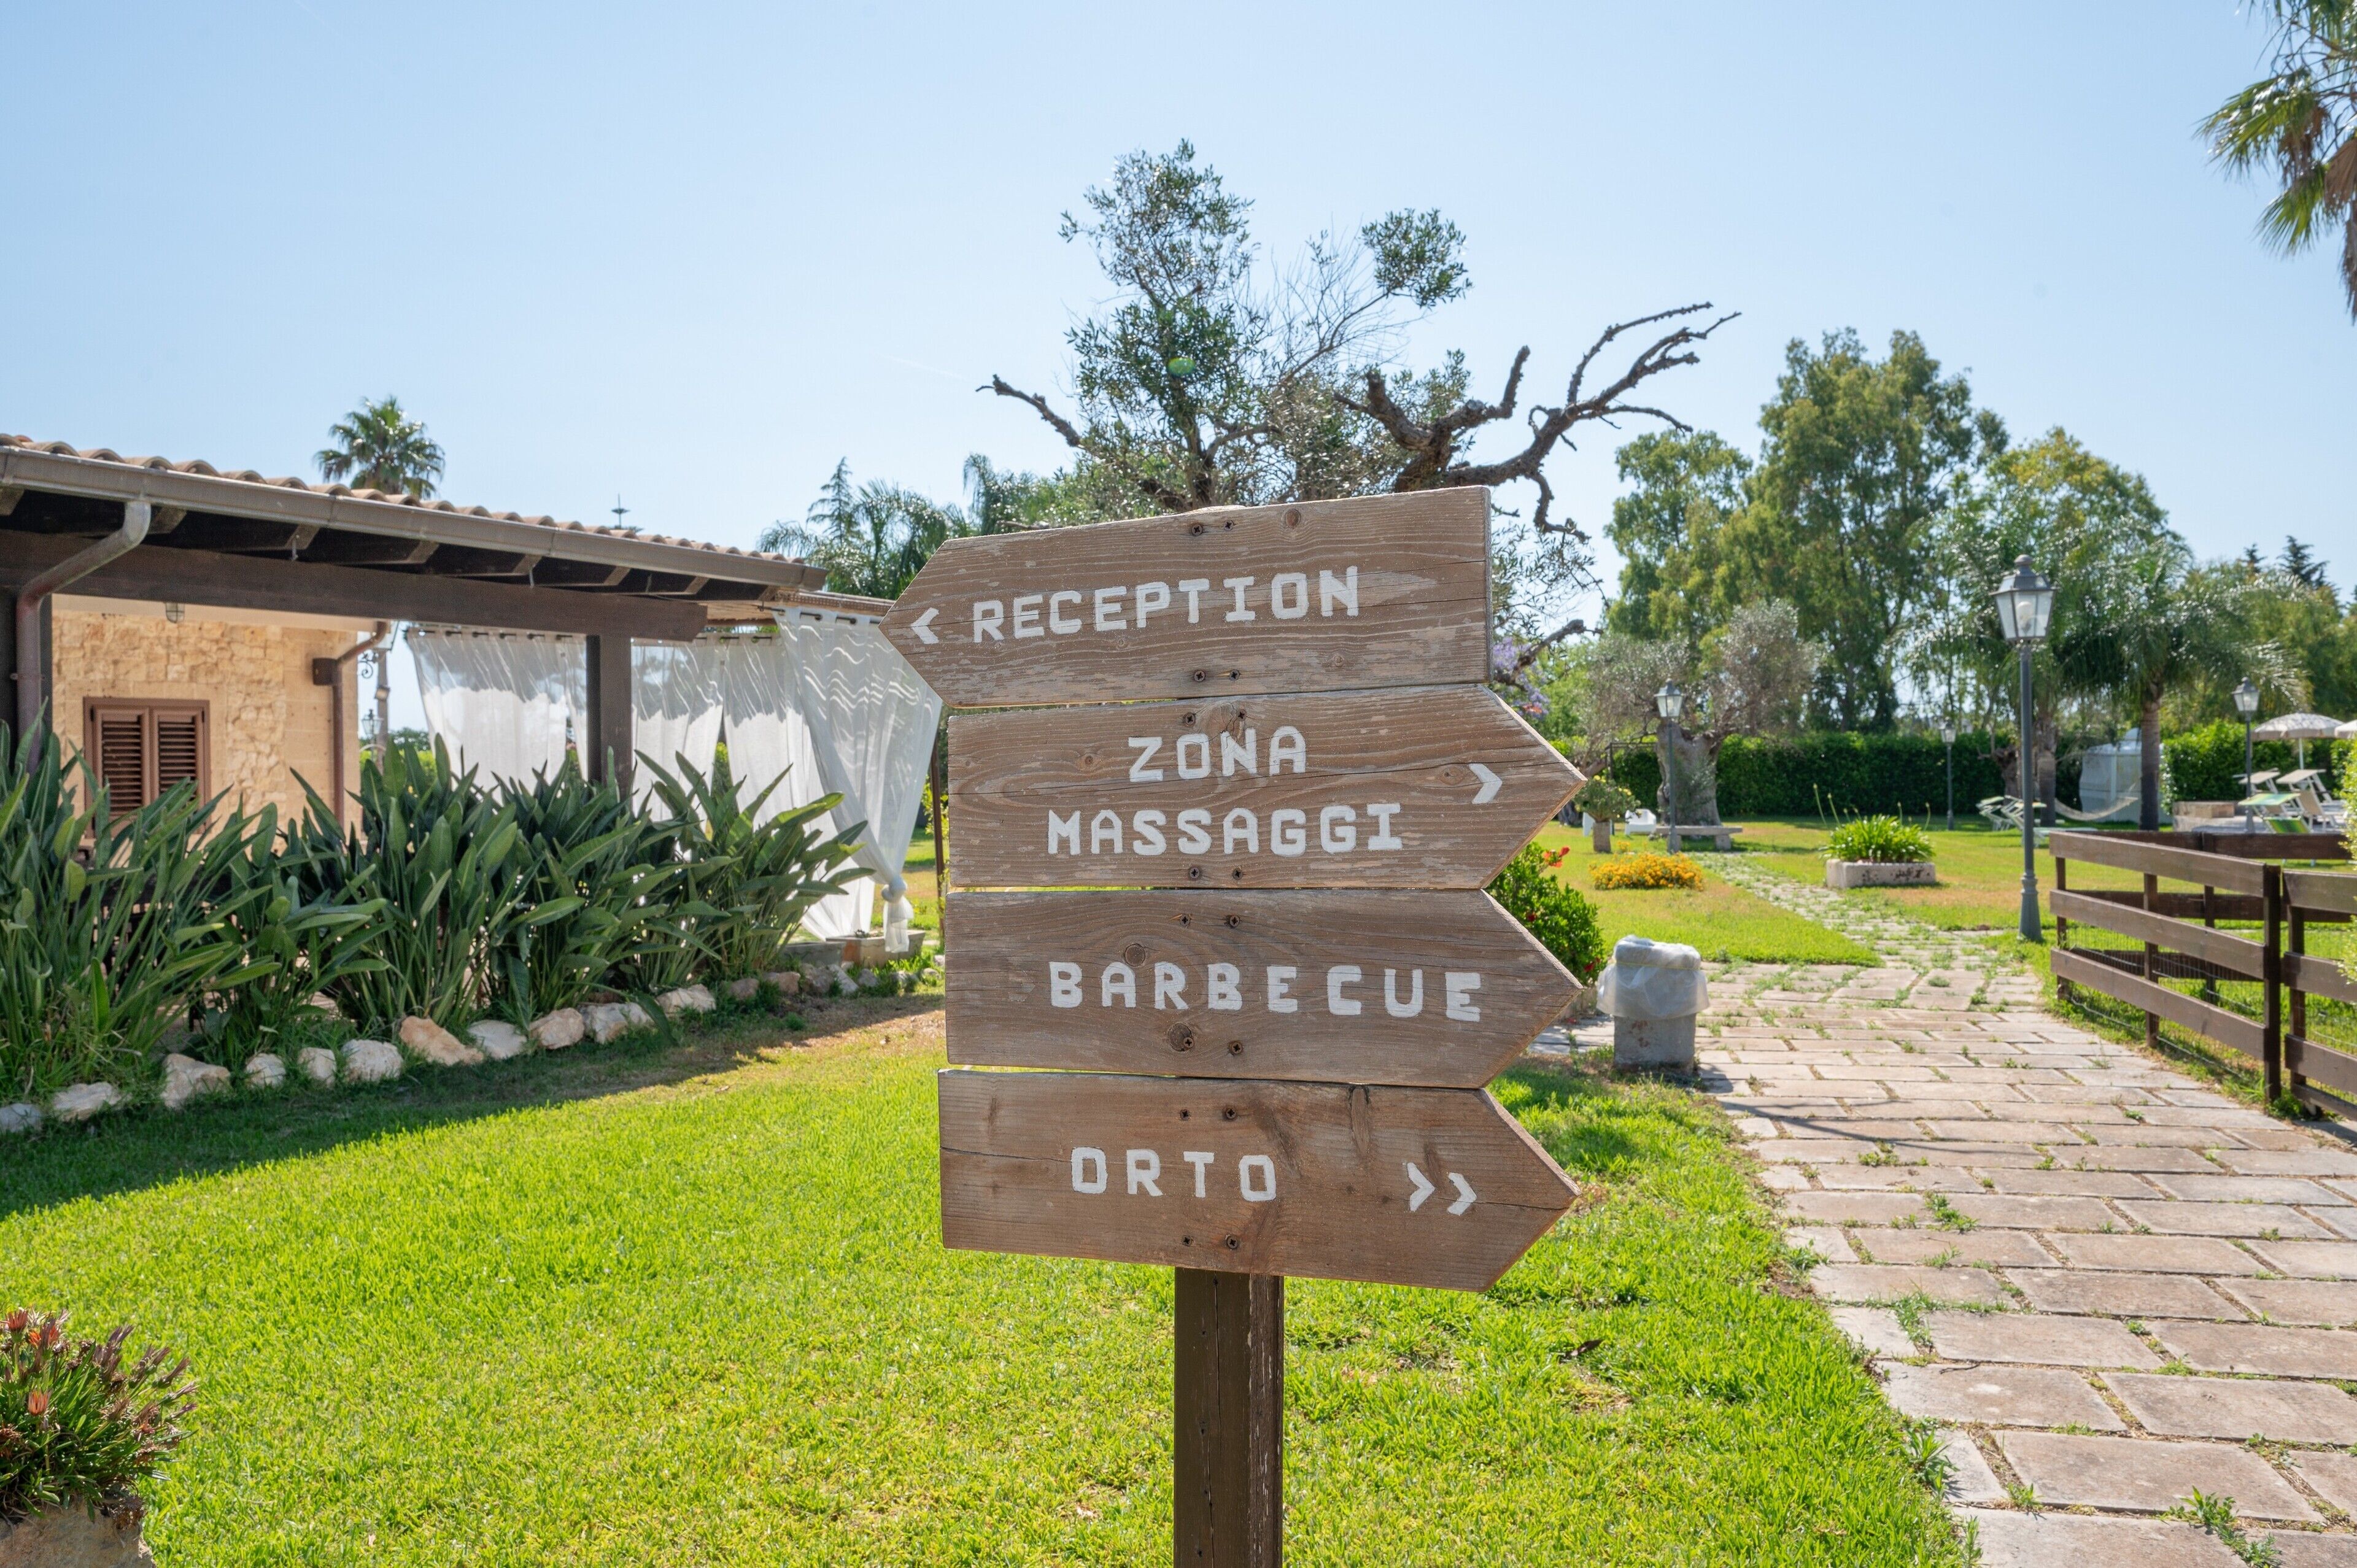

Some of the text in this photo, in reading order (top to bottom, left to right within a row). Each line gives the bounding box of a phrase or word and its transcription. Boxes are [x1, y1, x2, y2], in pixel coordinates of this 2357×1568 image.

[973, 565, 1359, 643] RECEPTION
[1128, 726, 1307, 782] ZONA
[1048, 803, 1403, 857] MASSAGGI
[1050, 962, 1482, 1022] BARBECUE
[1070, 1146, 1277, 1202] ORTO
